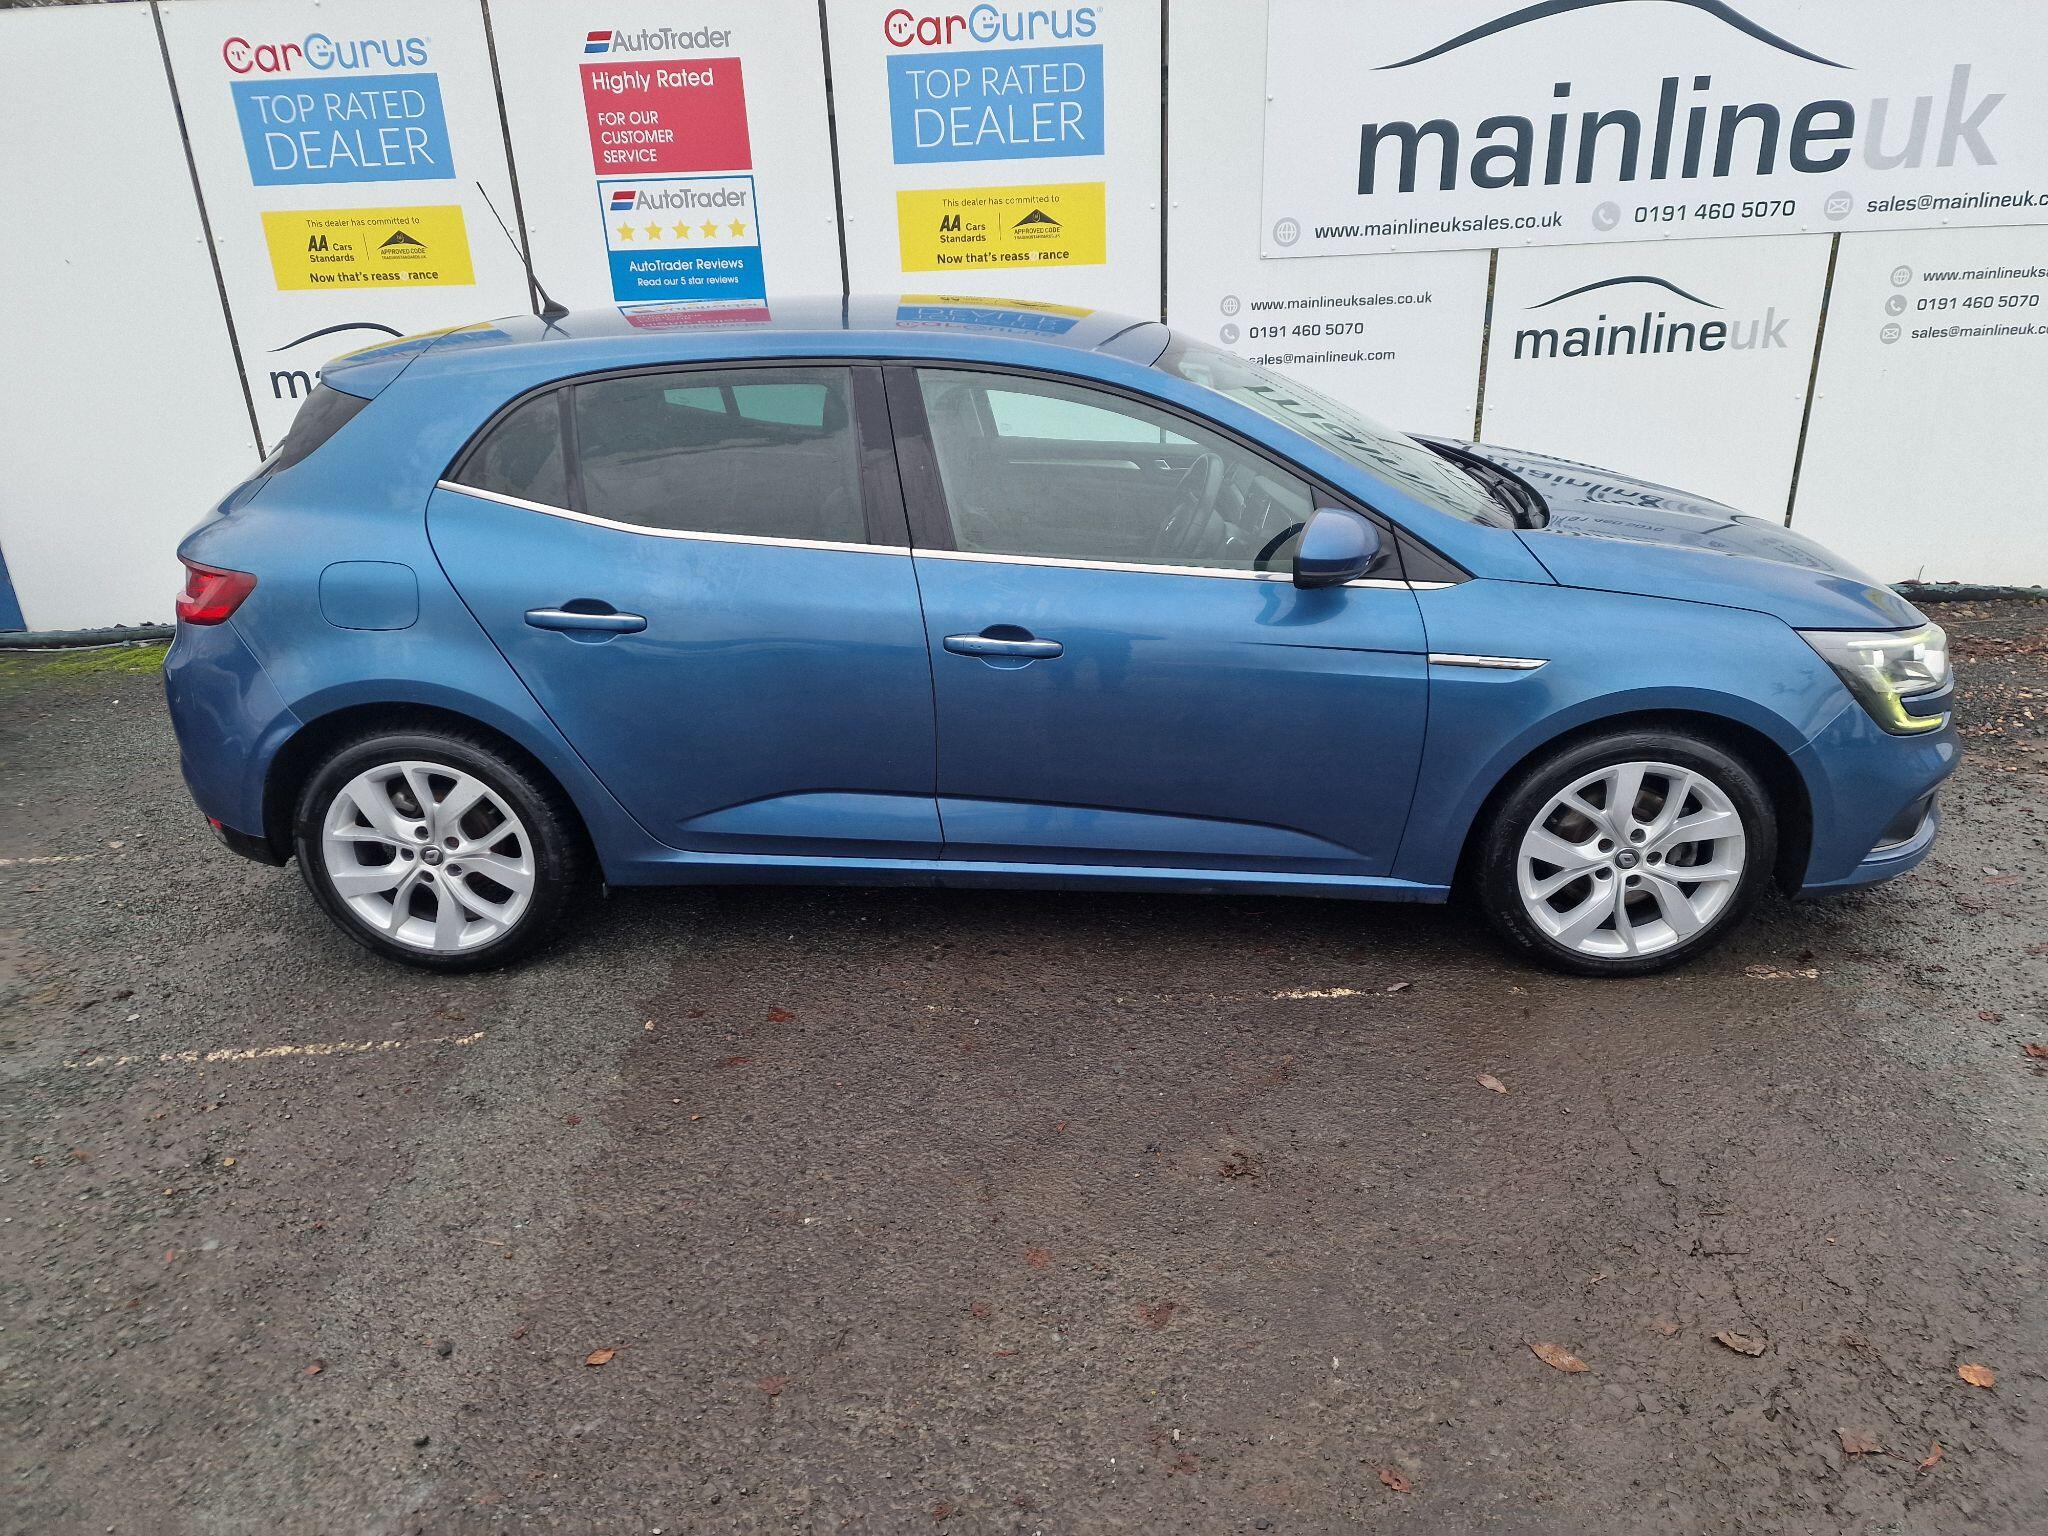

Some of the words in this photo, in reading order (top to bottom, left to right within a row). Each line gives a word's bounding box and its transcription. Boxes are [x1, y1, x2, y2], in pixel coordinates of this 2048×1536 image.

[884, 3, 1097, 48] CarGurus
[611, 26, 731, 52] AutoTrader
[222, 32, 428, 74] CarGurus
[592, 71, 650, 94] Highly
[656, 68, 714, 88] Rated
[906, 68, 971, 100] TOP
[981, 62, 1086, 97] RATED
[250, 94, 315, 124] TOP
[324, 89, 426, 121] RATED
[598, 112, 625, 126] FOR
[629, 110, 659, 125] OUR
[914, 101, 1086, 148] DEALER
[601, 129, 674, 145] CUSTOMER
[1357, 63, 2007, 196] mainlineuk
[264, 126, 435, 171] DEALER
[603, 149, 658, 164] SERVICE
[636, 187, 746, 211] AutoTrader
[942, 198, 959, 207] This
[961, 198, 986, 207] dealer
[988, 197, 1003, 206] has
[1005, 195, 1049, 205] committed
[1050, 195, 1060, 203] to
[1634, 204, 1687, 224] 0191
[1694, 201, 1735, 220] 460
[1740, 199, 1796, 219] 5070
[306, 219, 323, 228] This
[324, 218, 350, 227] dealer
[351, 218, 366, 227] has
[367, 217, 410, 226] committed
[411, 216, 420, 225] to
[939, 214, 961, 232] AA
[965, 222, 986, 231] Cars
[1314, 211, 1563, 239] www.mainlineuksales.co.uk
[307, 234, 329, 252] AA
[332, 243, 353, 251] Cars
[939, 233, 987, 243] Standards
[309, 254, 355, 263] Standards
[629, 259, 693, 272] AutoTrader
[696, 258, 744, 270] Reviews
[937, 253, 963, 264] Now
[966, 251, 997, 263] that's
[1000, 250, 1070, 262] reassrance
[309, 272, 335, 283] Now
[337, 272, 368, 282] that's
[371, 270, 439, 281] reassrance
[637, 277, 662, 287] Read
[663, 278, 678, 286] our
[680, 277, 686, 285] 5
[688, 276, 704, 285] star
[706, 275, 739, 284] reviews
[1923, 265, 2048, 282] www.mainlineuks
[1250, 291, 1433, 311] www.mainlineuksales.co.uk
[1917, 297, 1956, 311] 0191
[1962, 296, 1994, 309] 460
[1998, 294, 2040, 308] 5070
[1249, 325, 1286, 339] 0191
[1291, 324, 1321, 337] 460
[1325, 322, 1364, 336] 5070
[1513, 306, 1790, 360] mainlineuk
[1911, 323, 2048, 339] sales@mainlineuk.c
